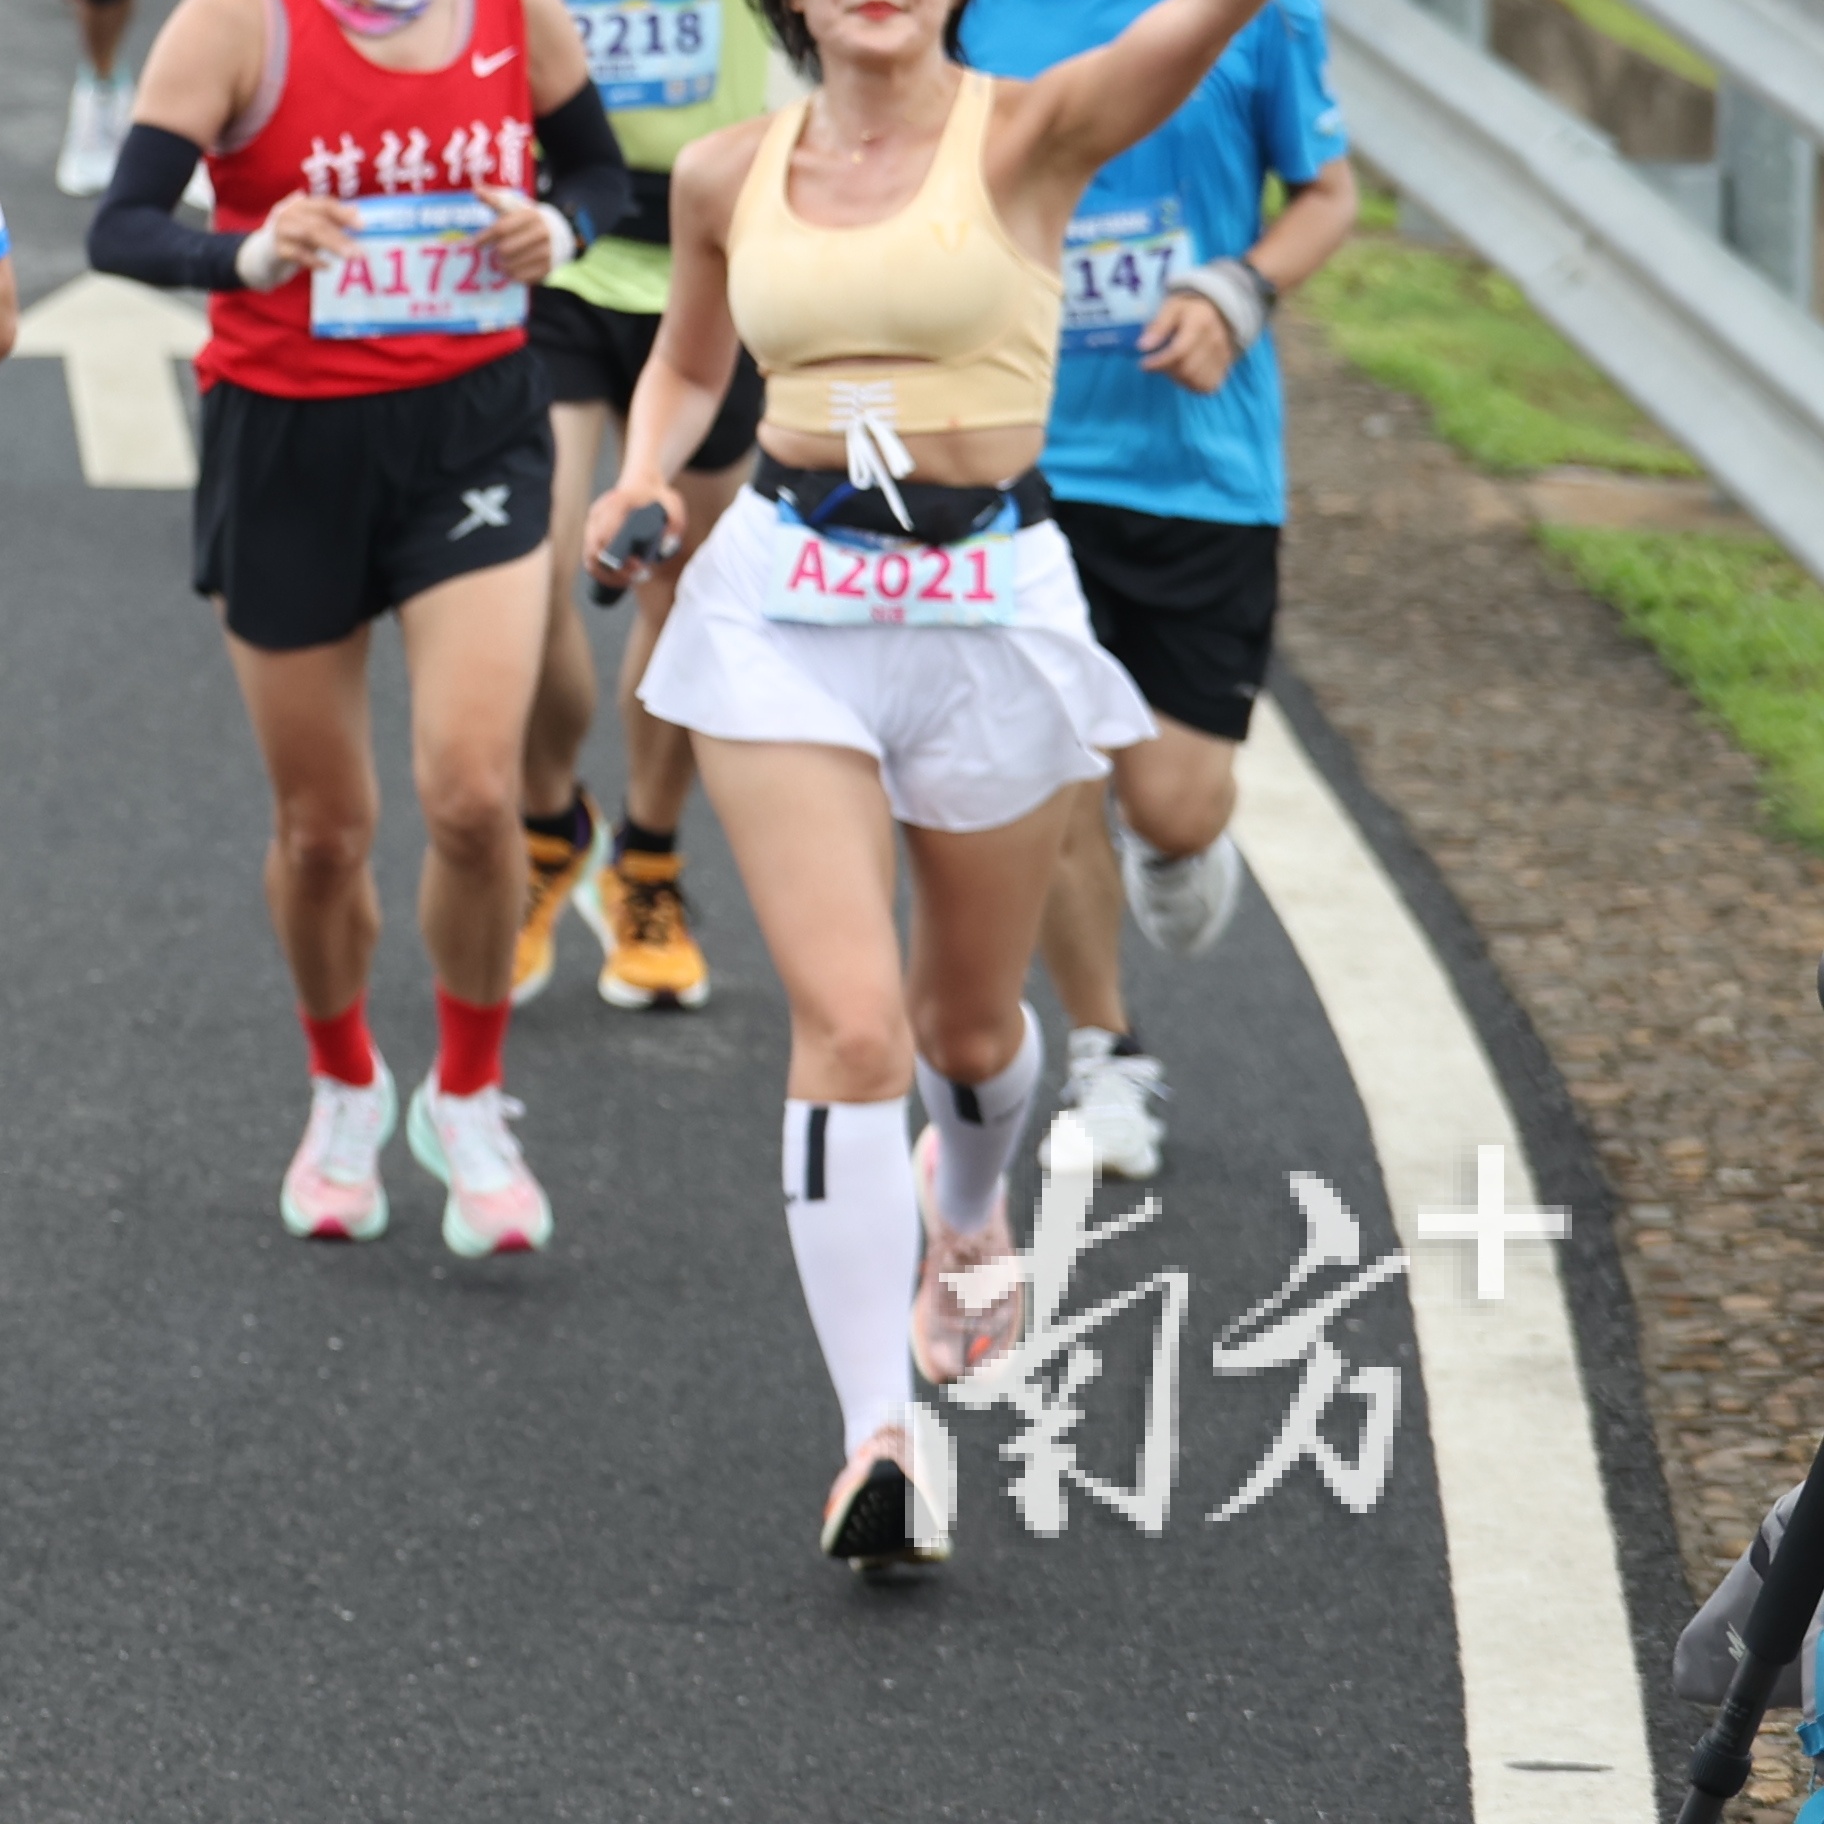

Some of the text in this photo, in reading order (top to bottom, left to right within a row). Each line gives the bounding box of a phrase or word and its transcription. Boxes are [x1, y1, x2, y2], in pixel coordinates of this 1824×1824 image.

[574, 10, 703, 57] 2218
[1074, 246, 1174, 300] 147
[787, 539, 996, 603] A2021
